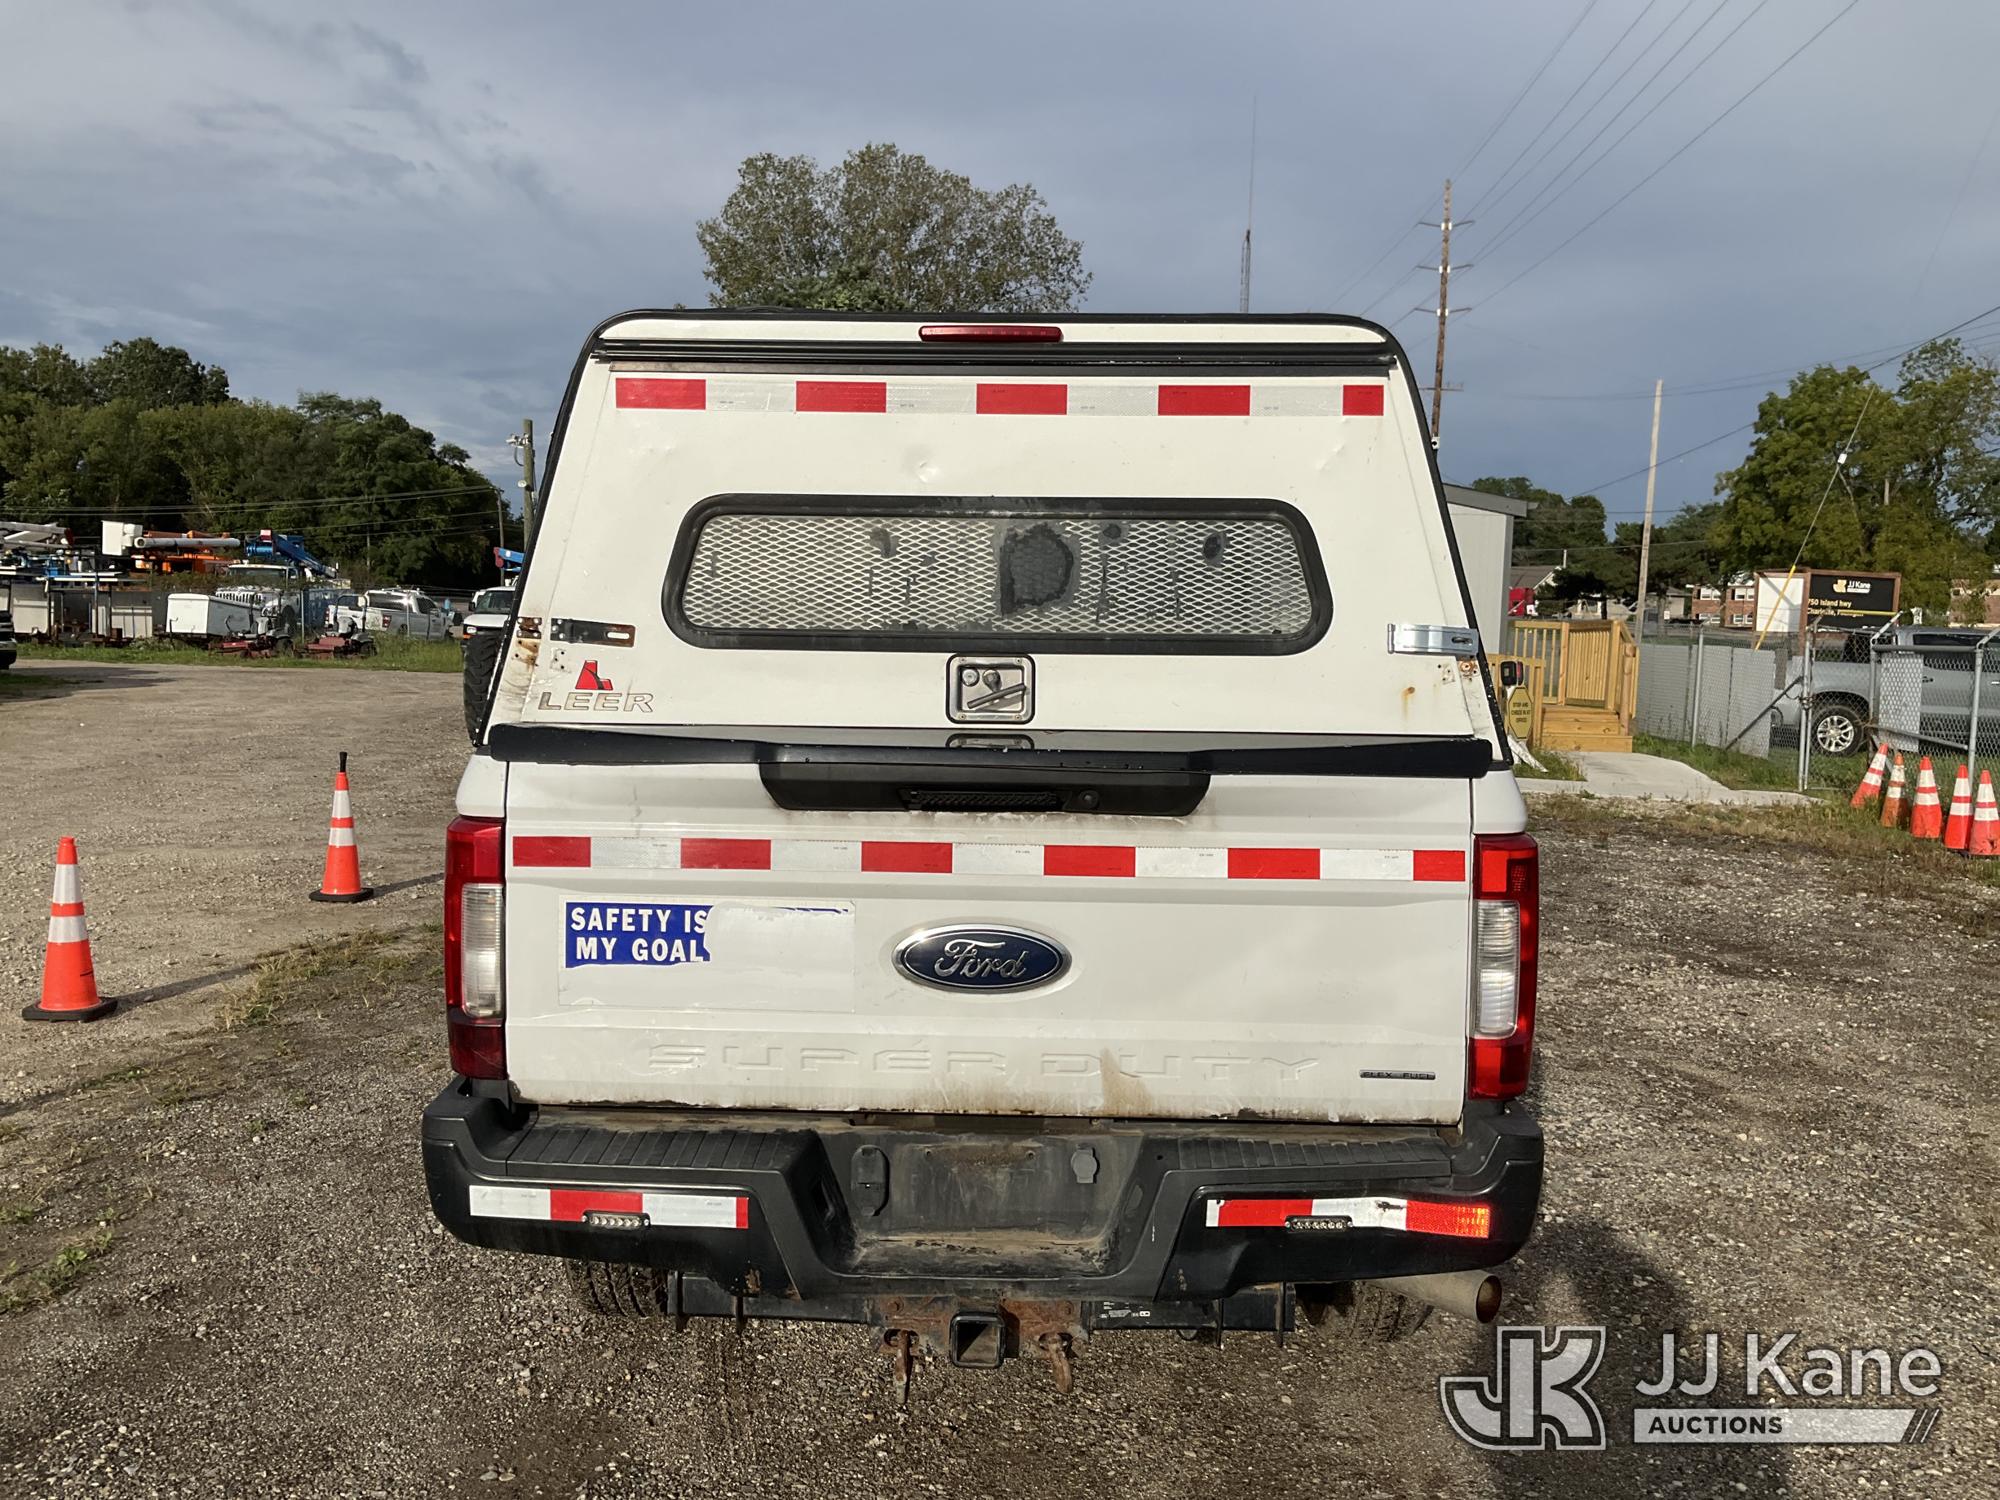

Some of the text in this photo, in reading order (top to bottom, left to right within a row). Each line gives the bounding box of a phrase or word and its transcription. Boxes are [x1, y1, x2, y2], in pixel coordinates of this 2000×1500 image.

[1855, 581, 1871, 589] Kane
[538, 692, 654, 713] LEER
[570, 907, 707, 934] SAFETY IS
[576, 937, 704, 962] MY GOAL
[934, 938, 1029, 978] Ford
[649, 1044, 1319, 1081] SUPER DUTY
